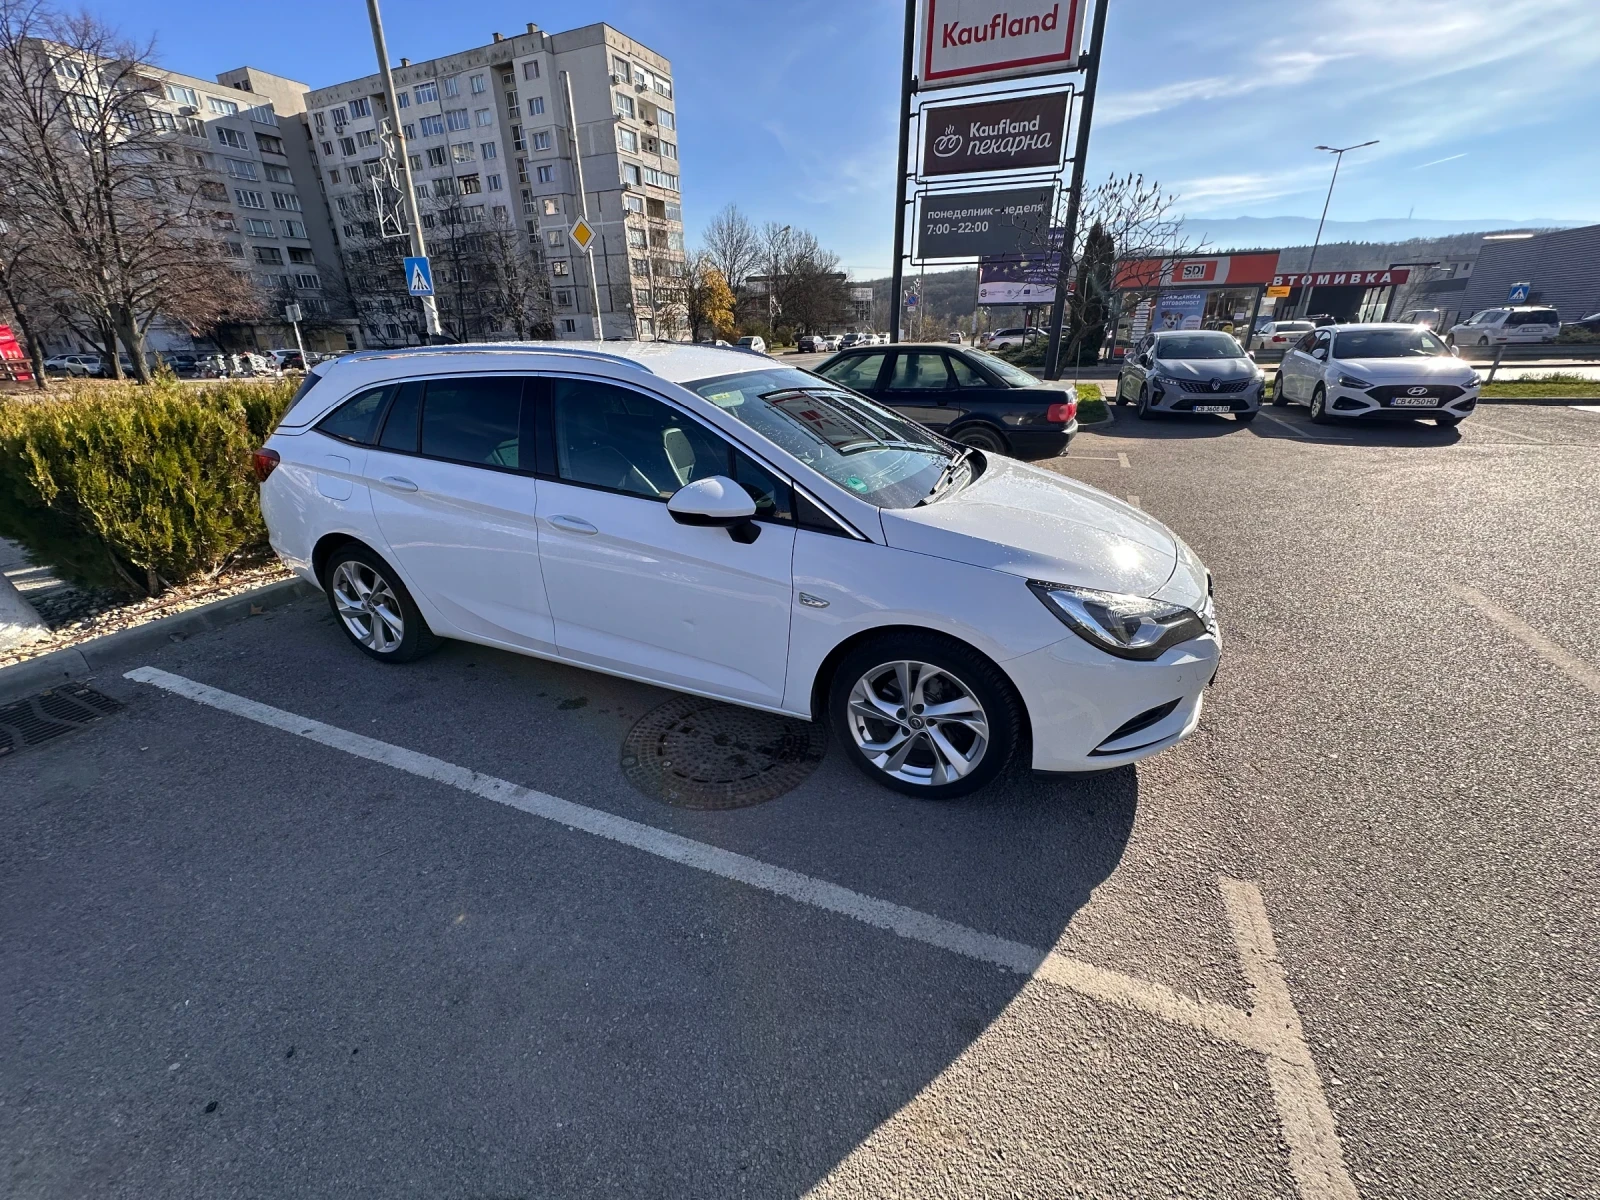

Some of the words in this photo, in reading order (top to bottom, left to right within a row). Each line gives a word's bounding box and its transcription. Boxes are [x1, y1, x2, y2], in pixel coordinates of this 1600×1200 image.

[942, 4, 1059, 48] Kaufland
[969, 115, 1040, 138] Kaufland
[967, 132, 1052, 156] пекарна
[927, 208, 994, 220] понеделник
[1001, 204, 1044, 216] неделя
[1184, 265, 1205, 276] SDI
[1265, 271, 1392, 286] ВТОМИВКА
